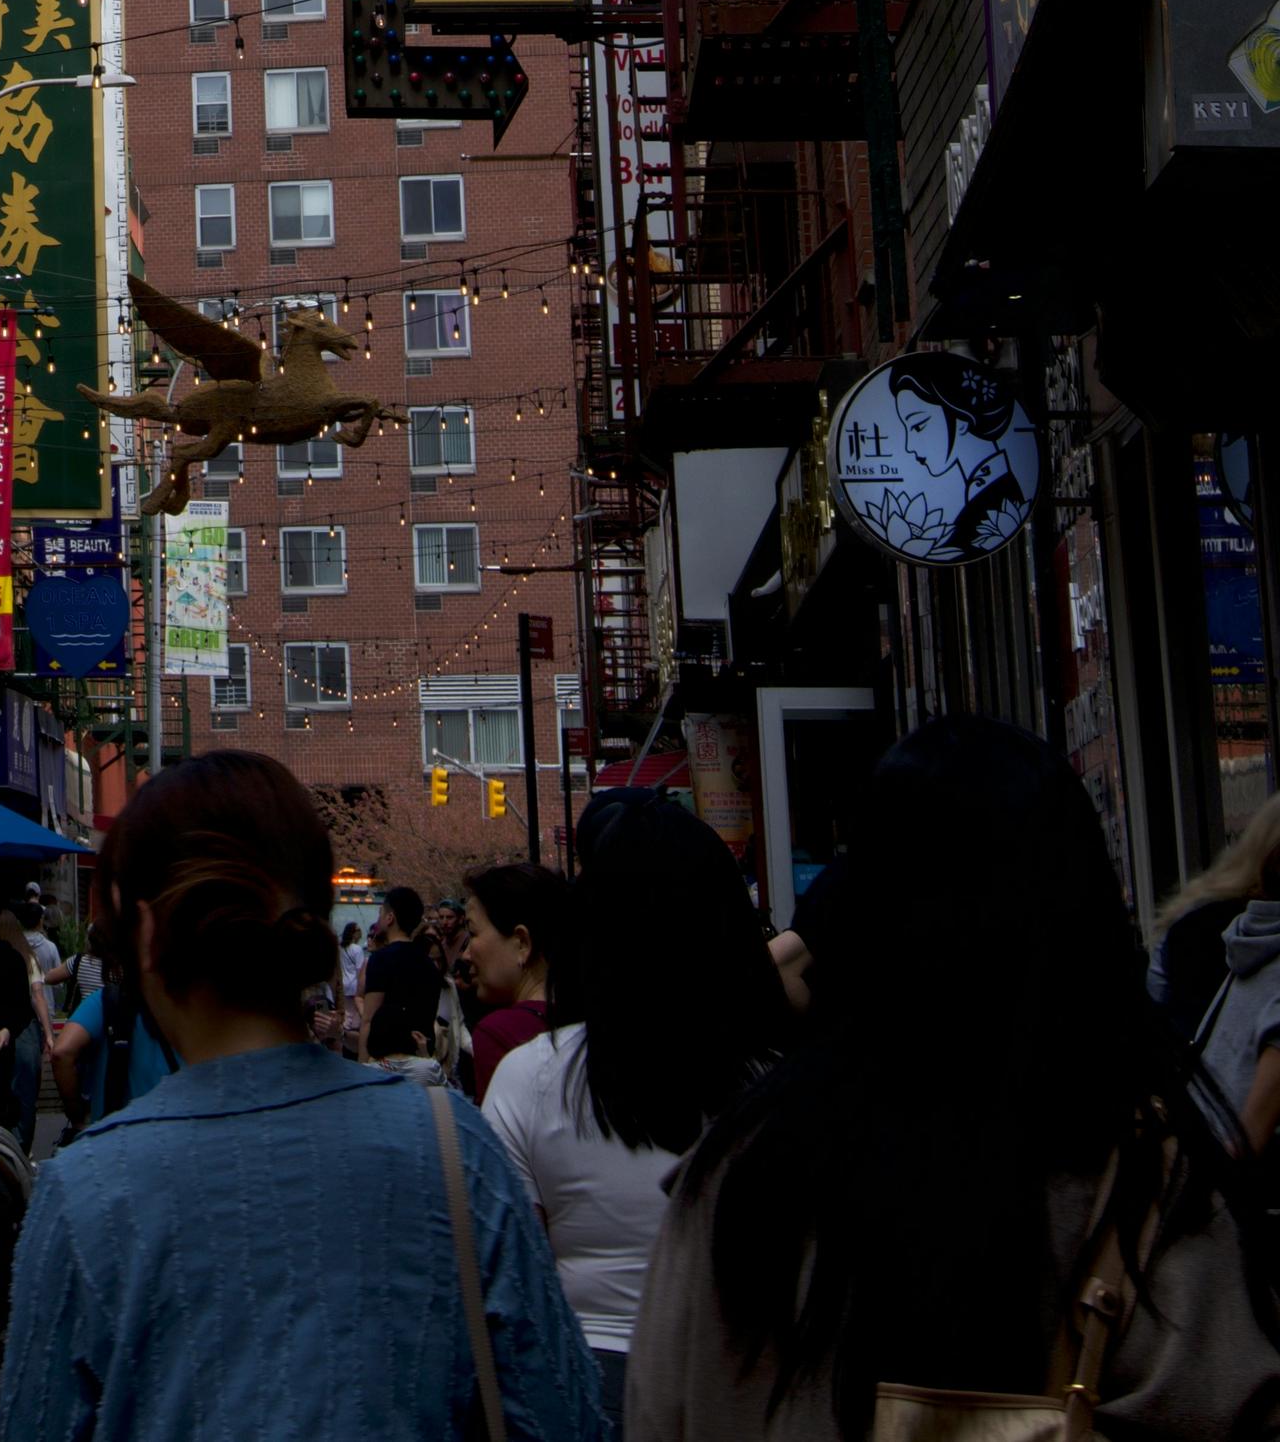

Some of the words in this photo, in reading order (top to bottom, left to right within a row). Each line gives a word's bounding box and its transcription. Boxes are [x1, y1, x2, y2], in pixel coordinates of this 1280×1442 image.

[1193, 100, 1249, 119] KEYI
[846, 464, 875, 475] Miss
[880, 464, 899, 475] Du
[41, 586, 117, 606] OCEAN
[64, 612, 107, 631] SPA
